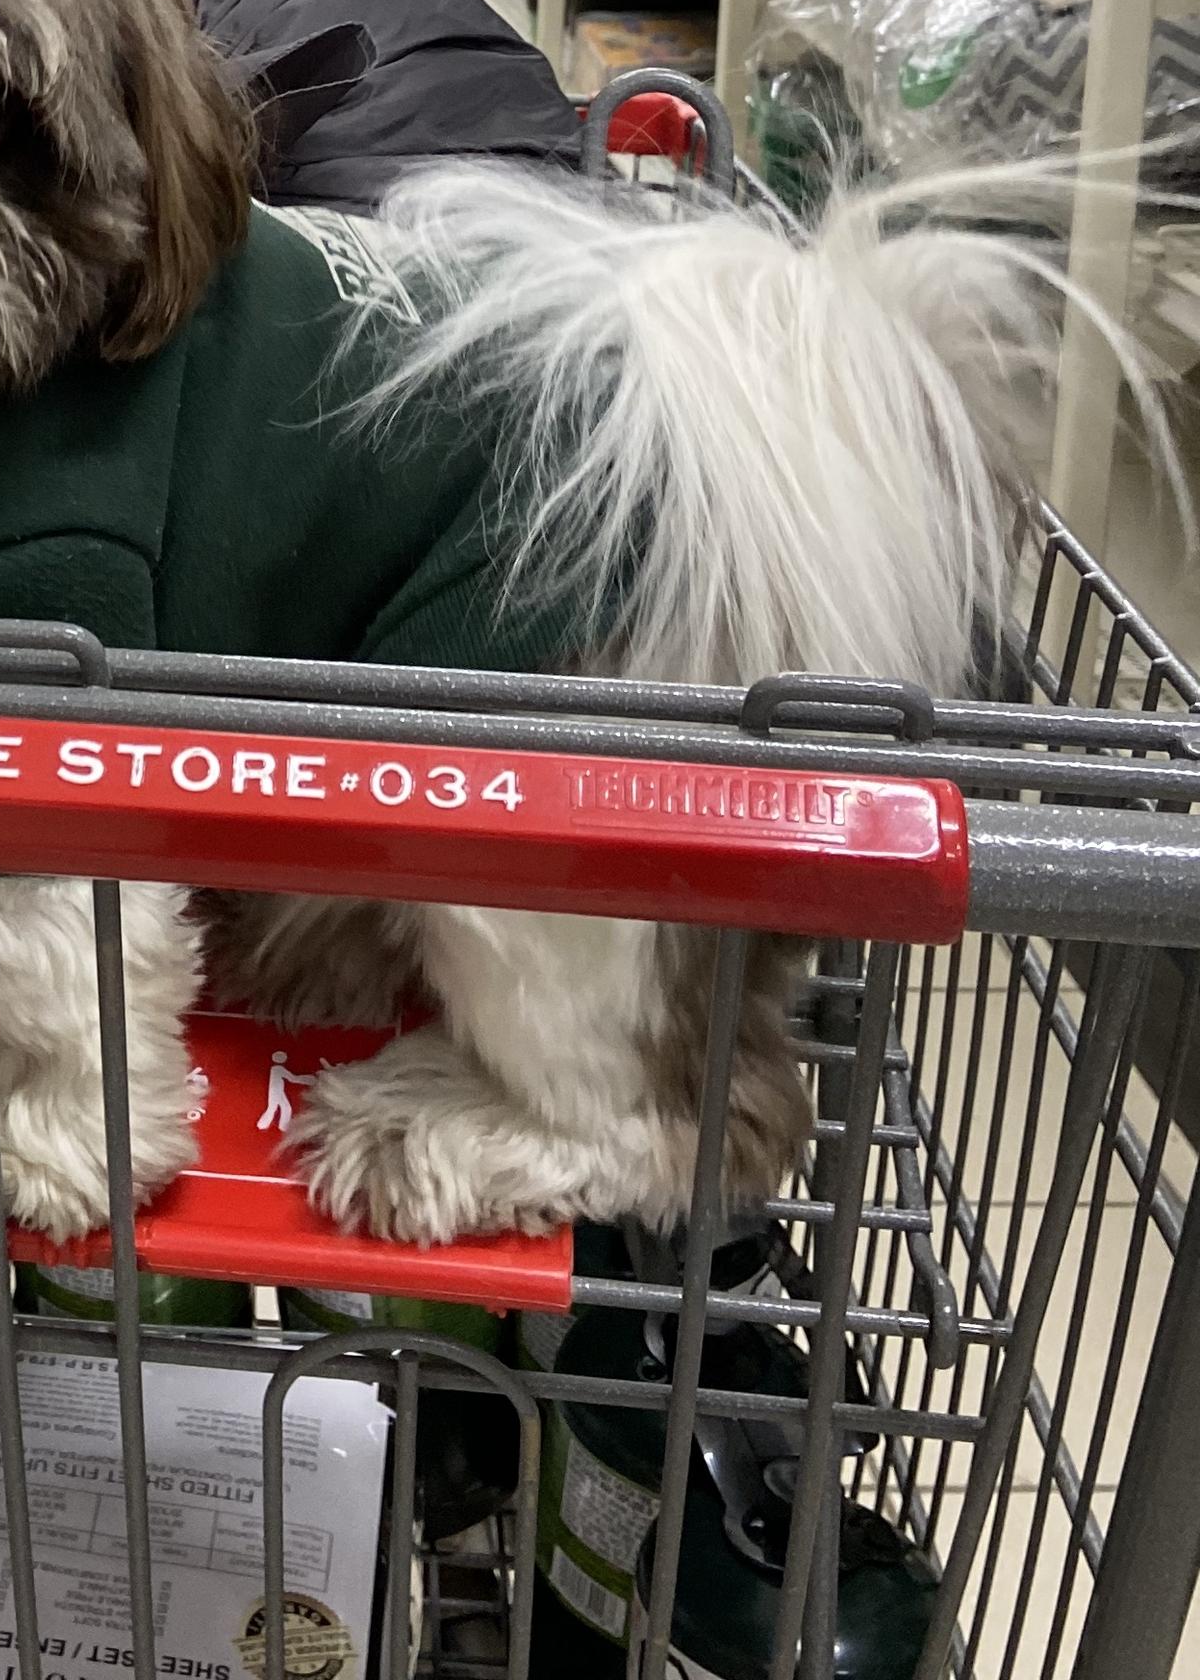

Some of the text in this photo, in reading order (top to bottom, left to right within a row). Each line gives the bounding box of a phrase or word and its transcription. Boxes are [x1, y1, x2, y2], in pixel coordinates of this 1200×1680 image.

[563, 767, 851, 826] TECHNIBILT
[54, 1460, 99, 1482] FITS
[104, 1470, 175, 1491] SHET
[180, 1479, 254, 1503] FITTED
[86, 1645, 134, 1667] SET
[155, 1654, 230, 1680] SHEE
